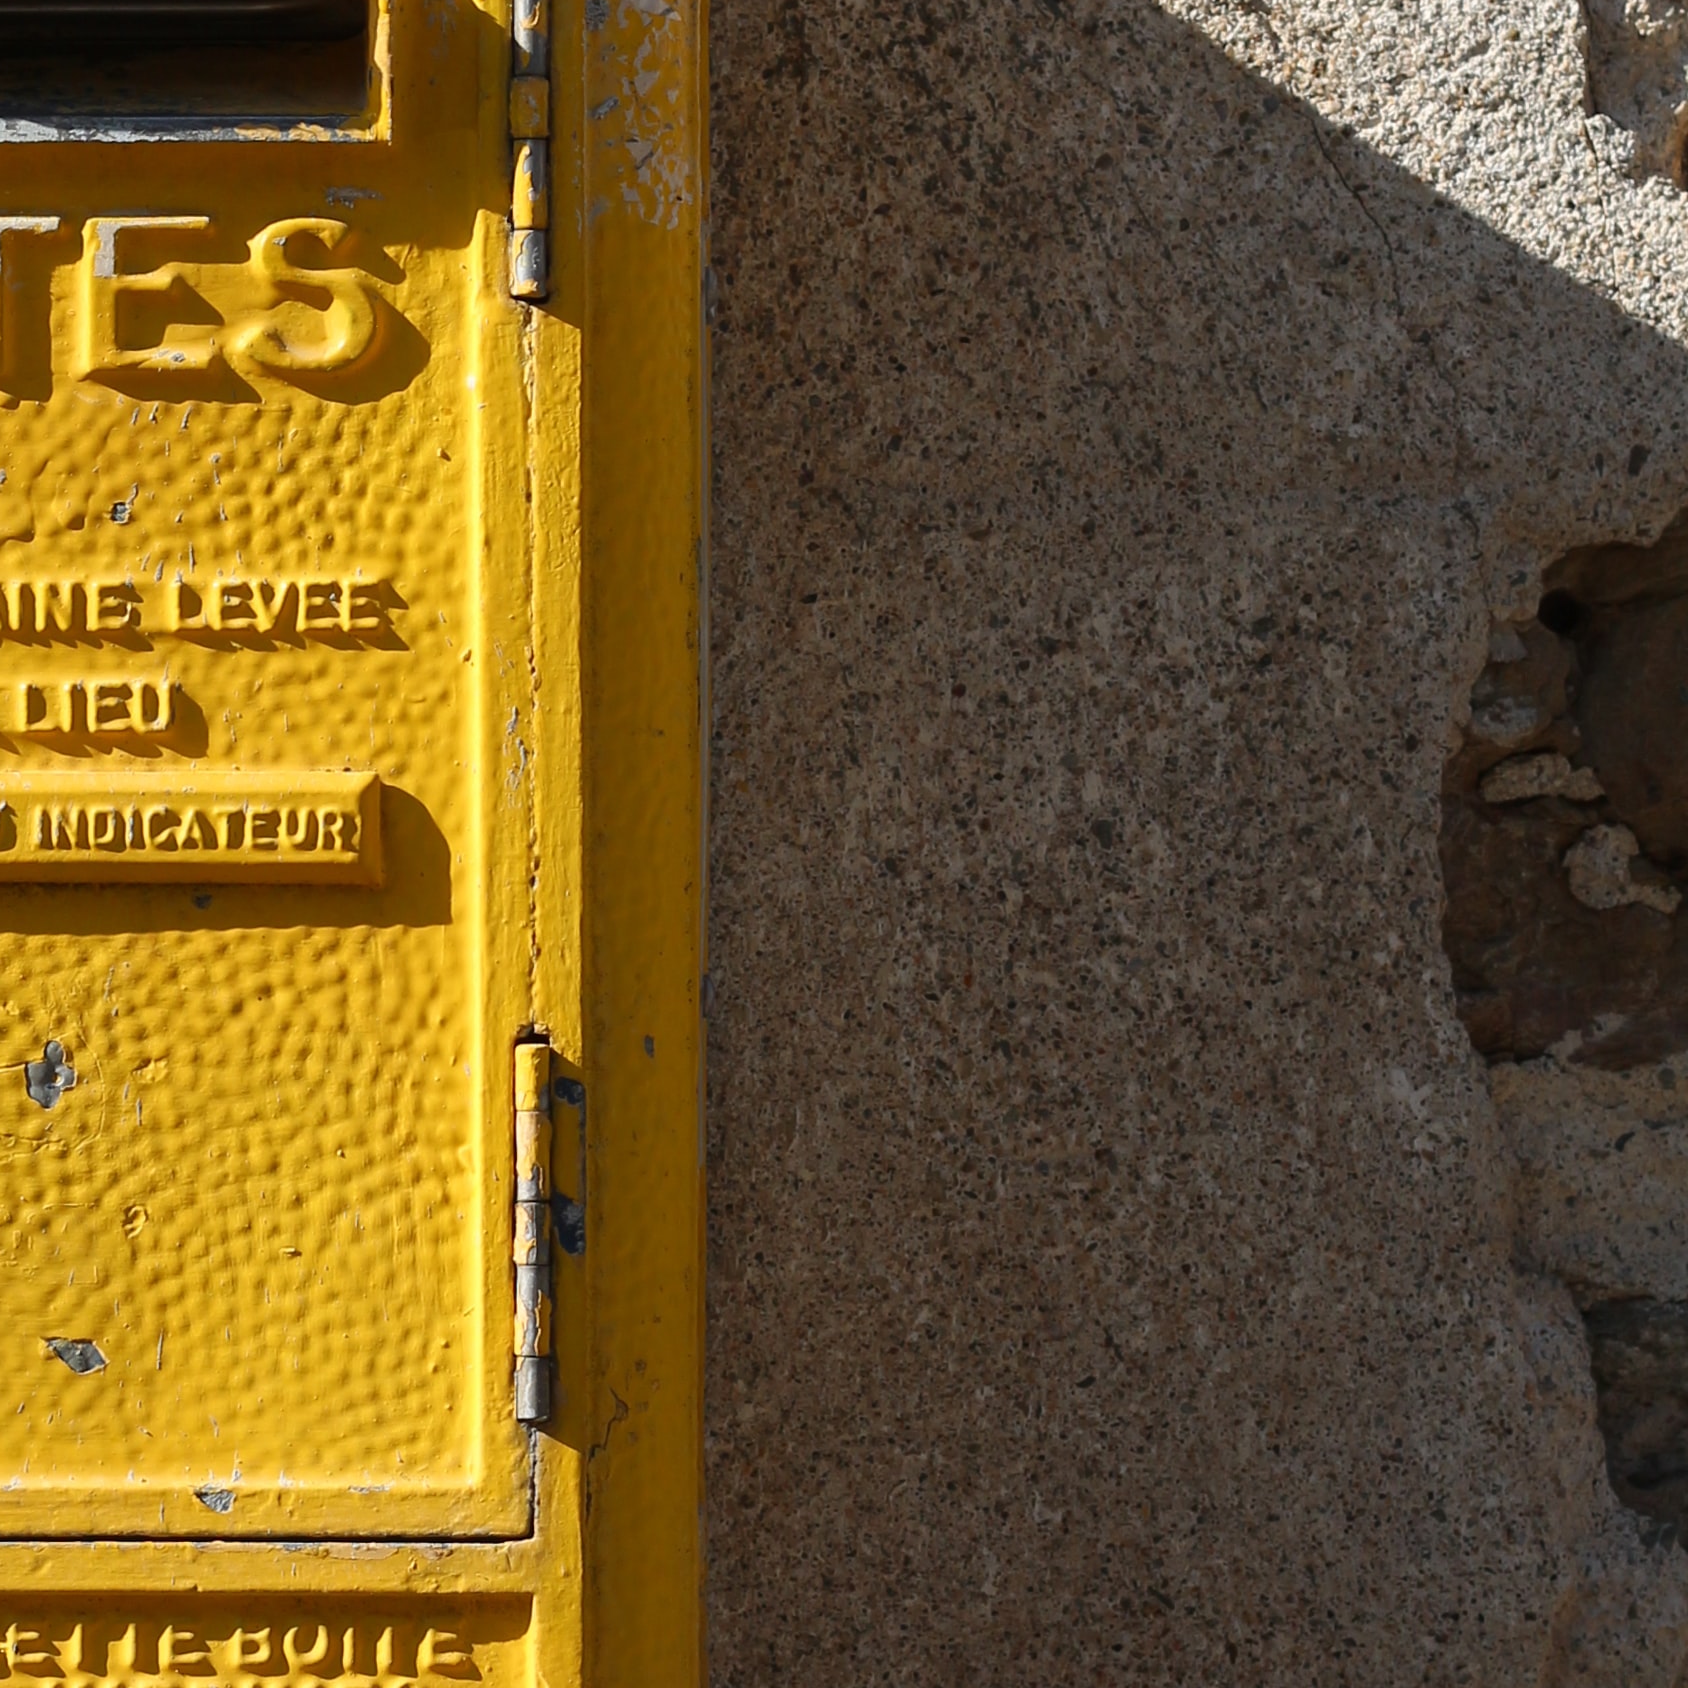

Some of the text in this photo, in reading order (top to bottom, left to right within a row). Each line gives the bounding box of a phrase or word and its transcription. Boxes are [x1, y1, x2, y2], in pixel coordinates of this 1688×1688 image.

[171, 579, 384, 631] LEVEE
[18, 681, 172, 732] LIEU
[35, 804, 344, 849] INDICATEUR
[232, 1624, 472, 1672] BOITE
